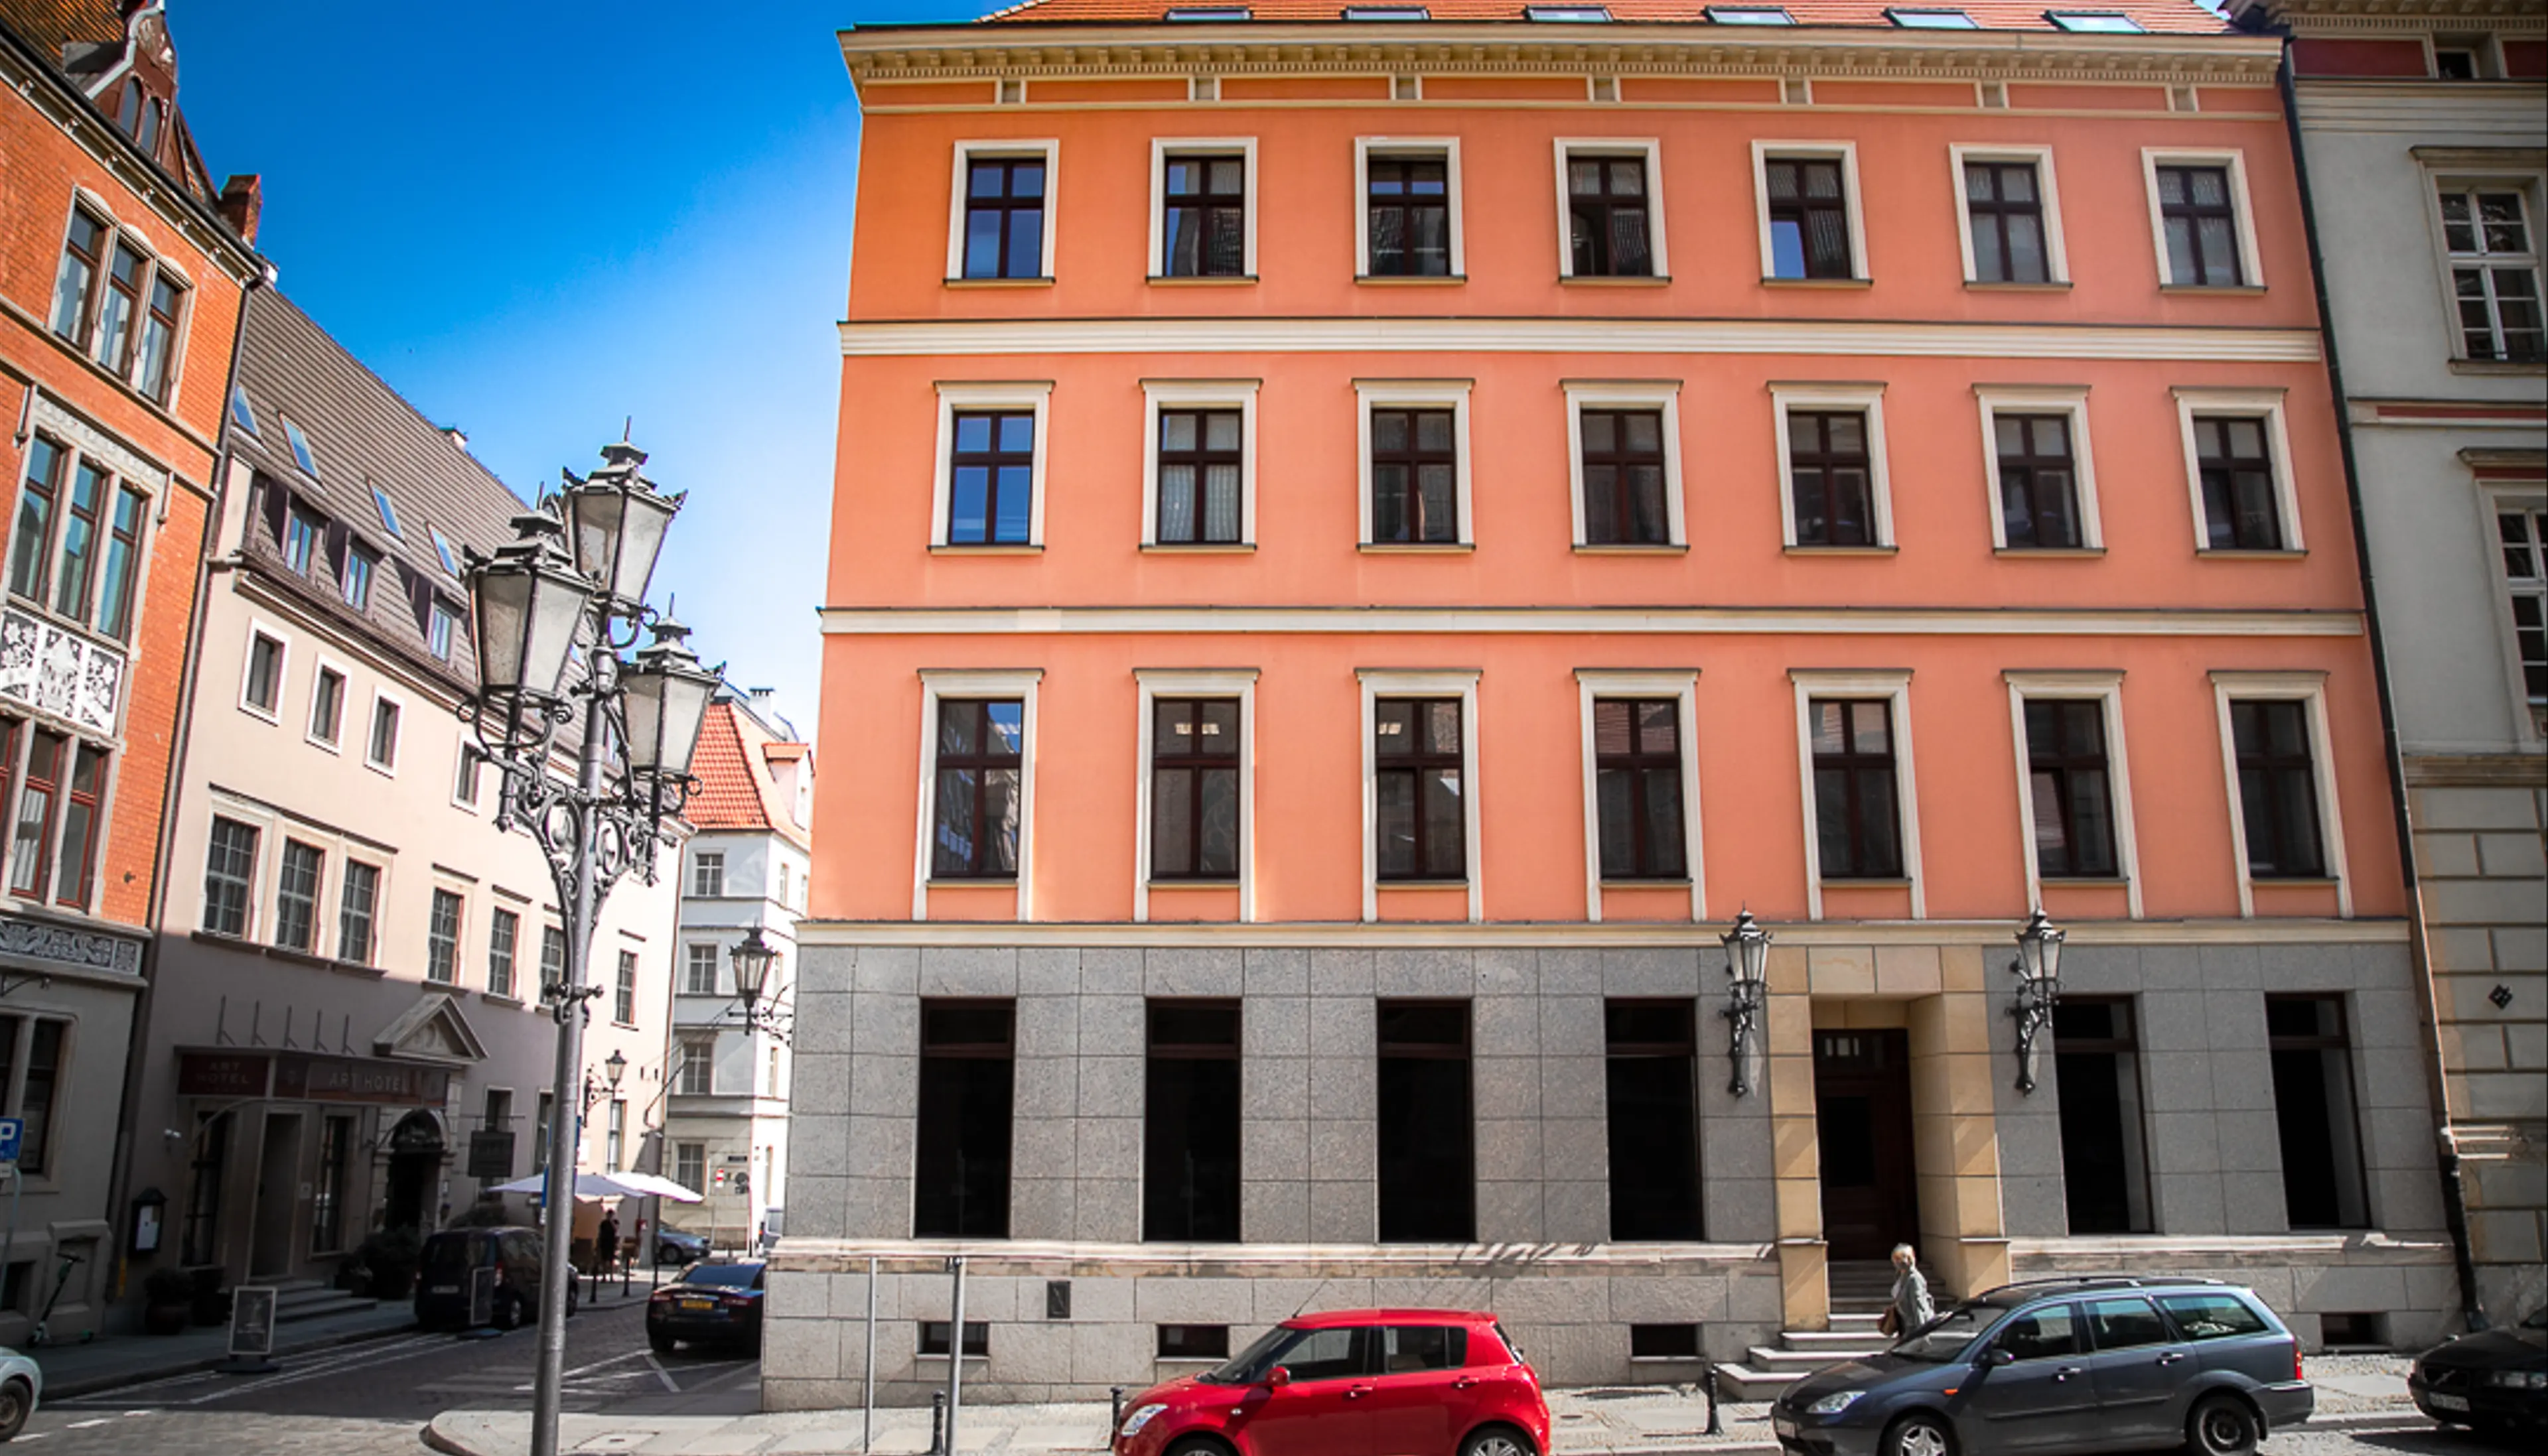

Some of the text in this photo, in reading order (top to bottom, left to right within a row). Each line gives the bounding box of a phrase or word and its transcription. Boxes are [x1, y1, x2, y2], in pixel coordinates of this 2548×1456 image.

[209, 1061, 241, 1071] ART
[329, 1073, 409, 1094] ART HOTEL
[0, 1122, 17, 1147] P
